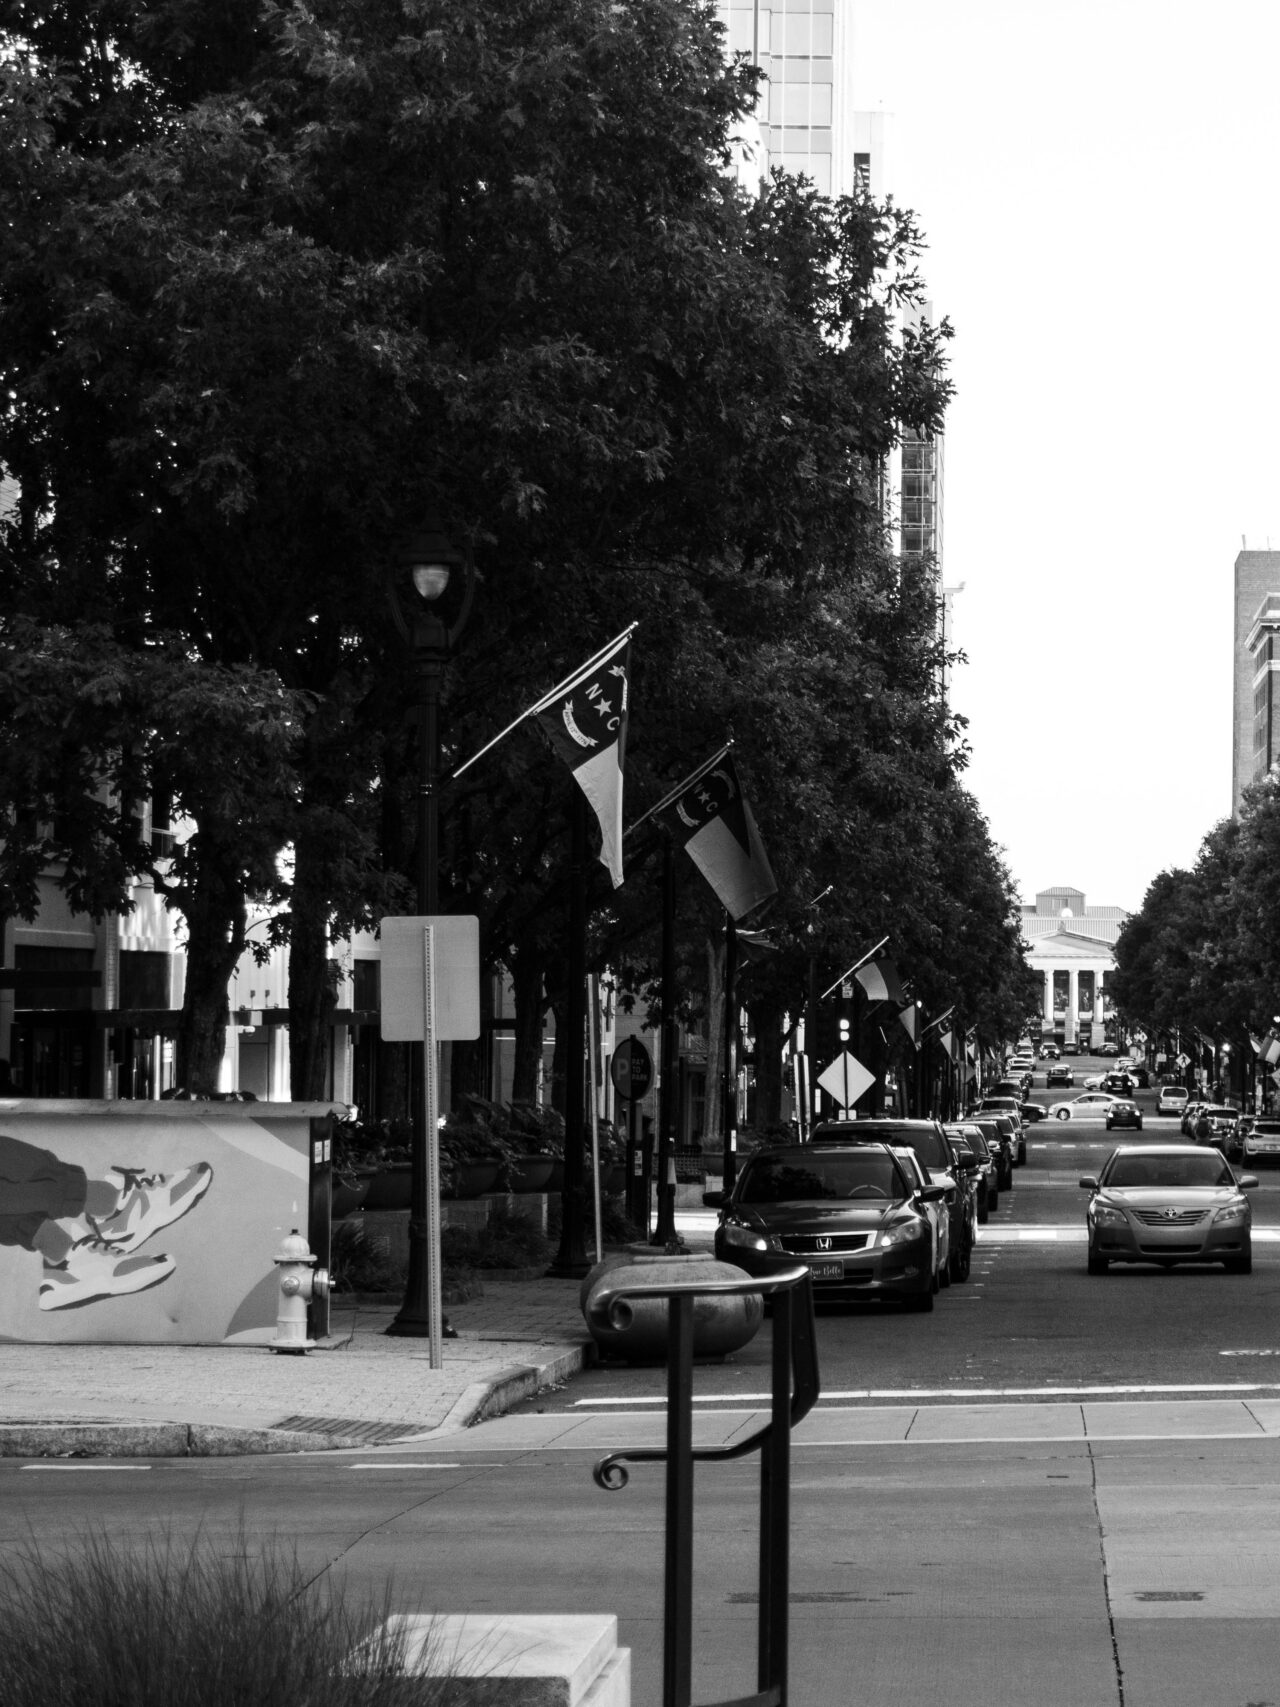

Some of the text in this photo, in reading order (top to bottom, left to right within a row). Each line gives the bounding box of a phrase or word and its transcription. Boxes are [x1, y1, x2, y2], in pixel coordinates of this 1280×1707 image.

[585, 683, 620, 731] N C
[705, 801, 719, 813] C
[616, 1058, 629, 1081] P
